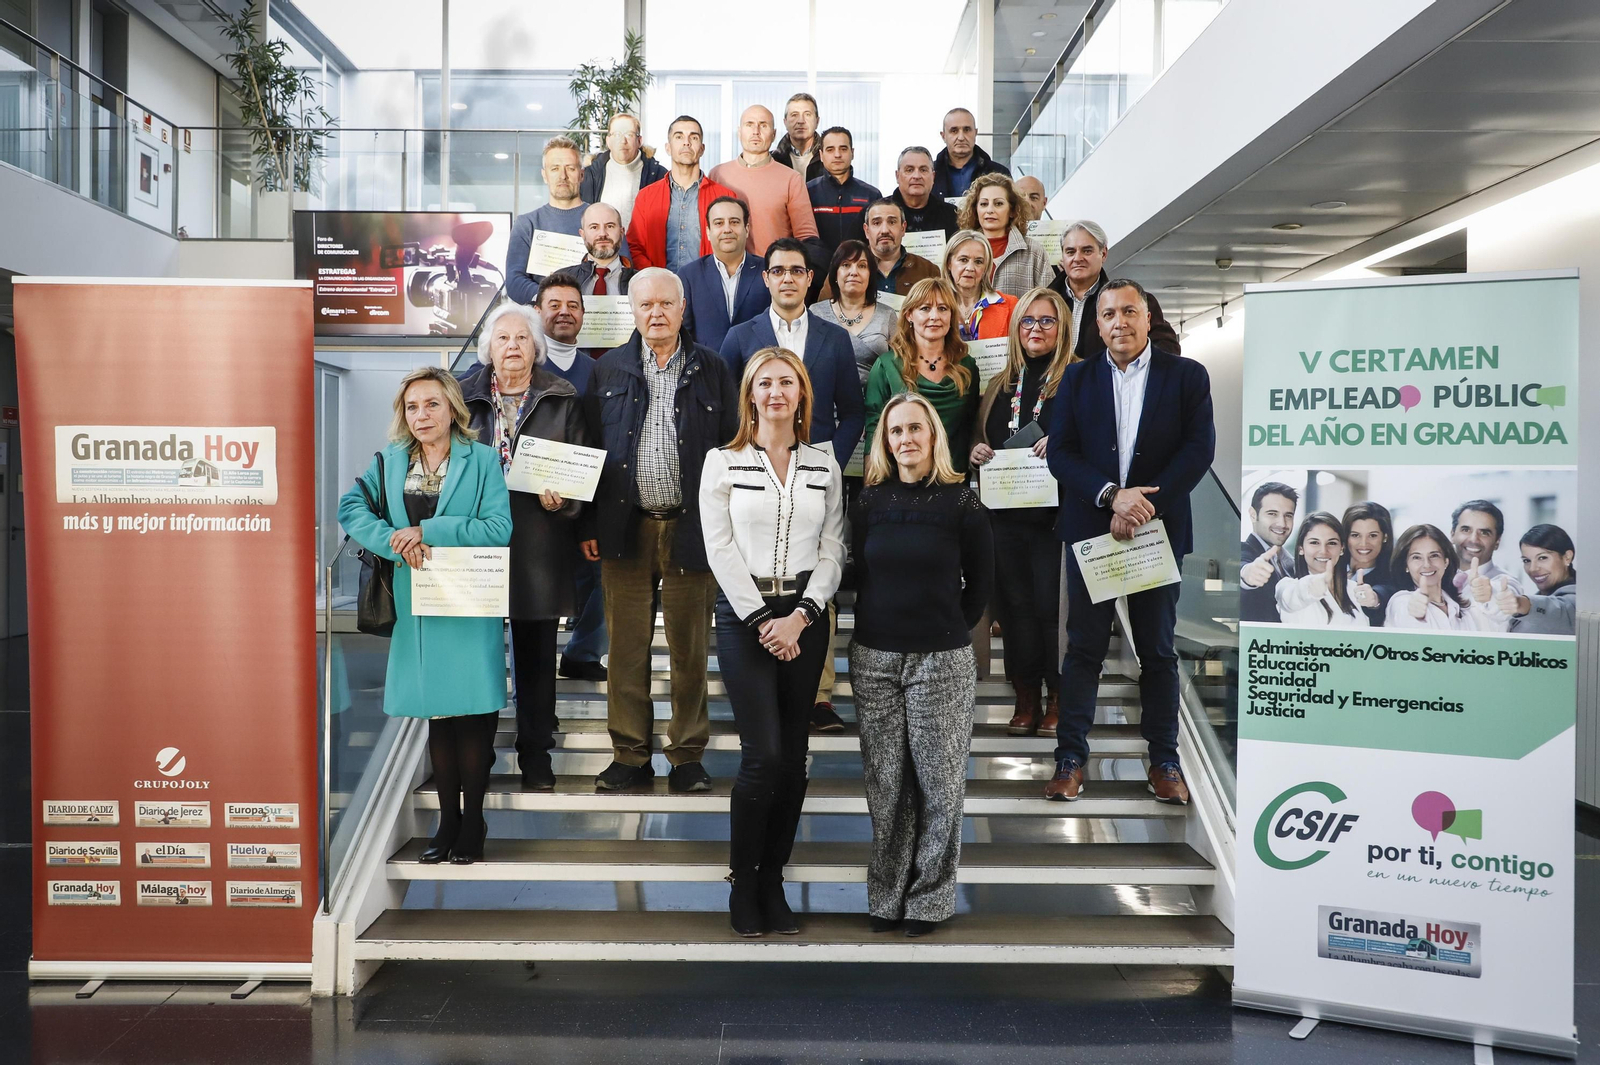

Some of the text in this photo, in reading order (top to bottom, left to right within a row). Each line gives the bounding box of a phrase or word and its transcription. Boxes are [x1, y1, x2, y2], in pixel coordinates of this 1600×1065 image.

[1299, 346, 1499, 374] V CERTAMEN
[1248, 416, 1568, 446] DEL AÑO EN GRANADA
[71, 433, 260, 468] Granada Hoy
[91, 494, 151, 504] Alhambra
[154, 494, 188, 504] acaba
[215, 495, 231, 505] las
[234, 495, 263, 505] colas
[63, 512, 271, 534] más y mejor información
[1248, 638, 1568, 670] Administración/Otros Servicios Públicos
[1248, 654, 1330, 673] Educación
[1248, 670, 1317, 688] Sanidad
[1248, 685, 1464, 713] Seguridad y Emergencias
[1246, 701, 1306, 718] Justicia
[133, 779, 210, 789] GRUPOJOLY
[48, 805, 77, 813] DIARIO
[78, 805, 88, 813] DE
[139, 806, 203, 818] Diario de Jerez
[229, 805, 282, 815] EuropaSur
[1274, 808, 1360, 843] CSIF
[49, 846, 118, 855] Diario de Sevilla
[156, 845, 186, 855] el Día
[230, 845, 267, 855] Huelva
[1368, 843, 1554, 880] por ti, contigo
[53, 883, 115, 894] Granada Hoy
[141, 884, 206, 896] Málaga hoy
[1366, 868, 1554, 902] en un nuevo tiempo
[1328, 911, 1418, 940] Granada
[1426, 922, 1469, 951] Hoy
